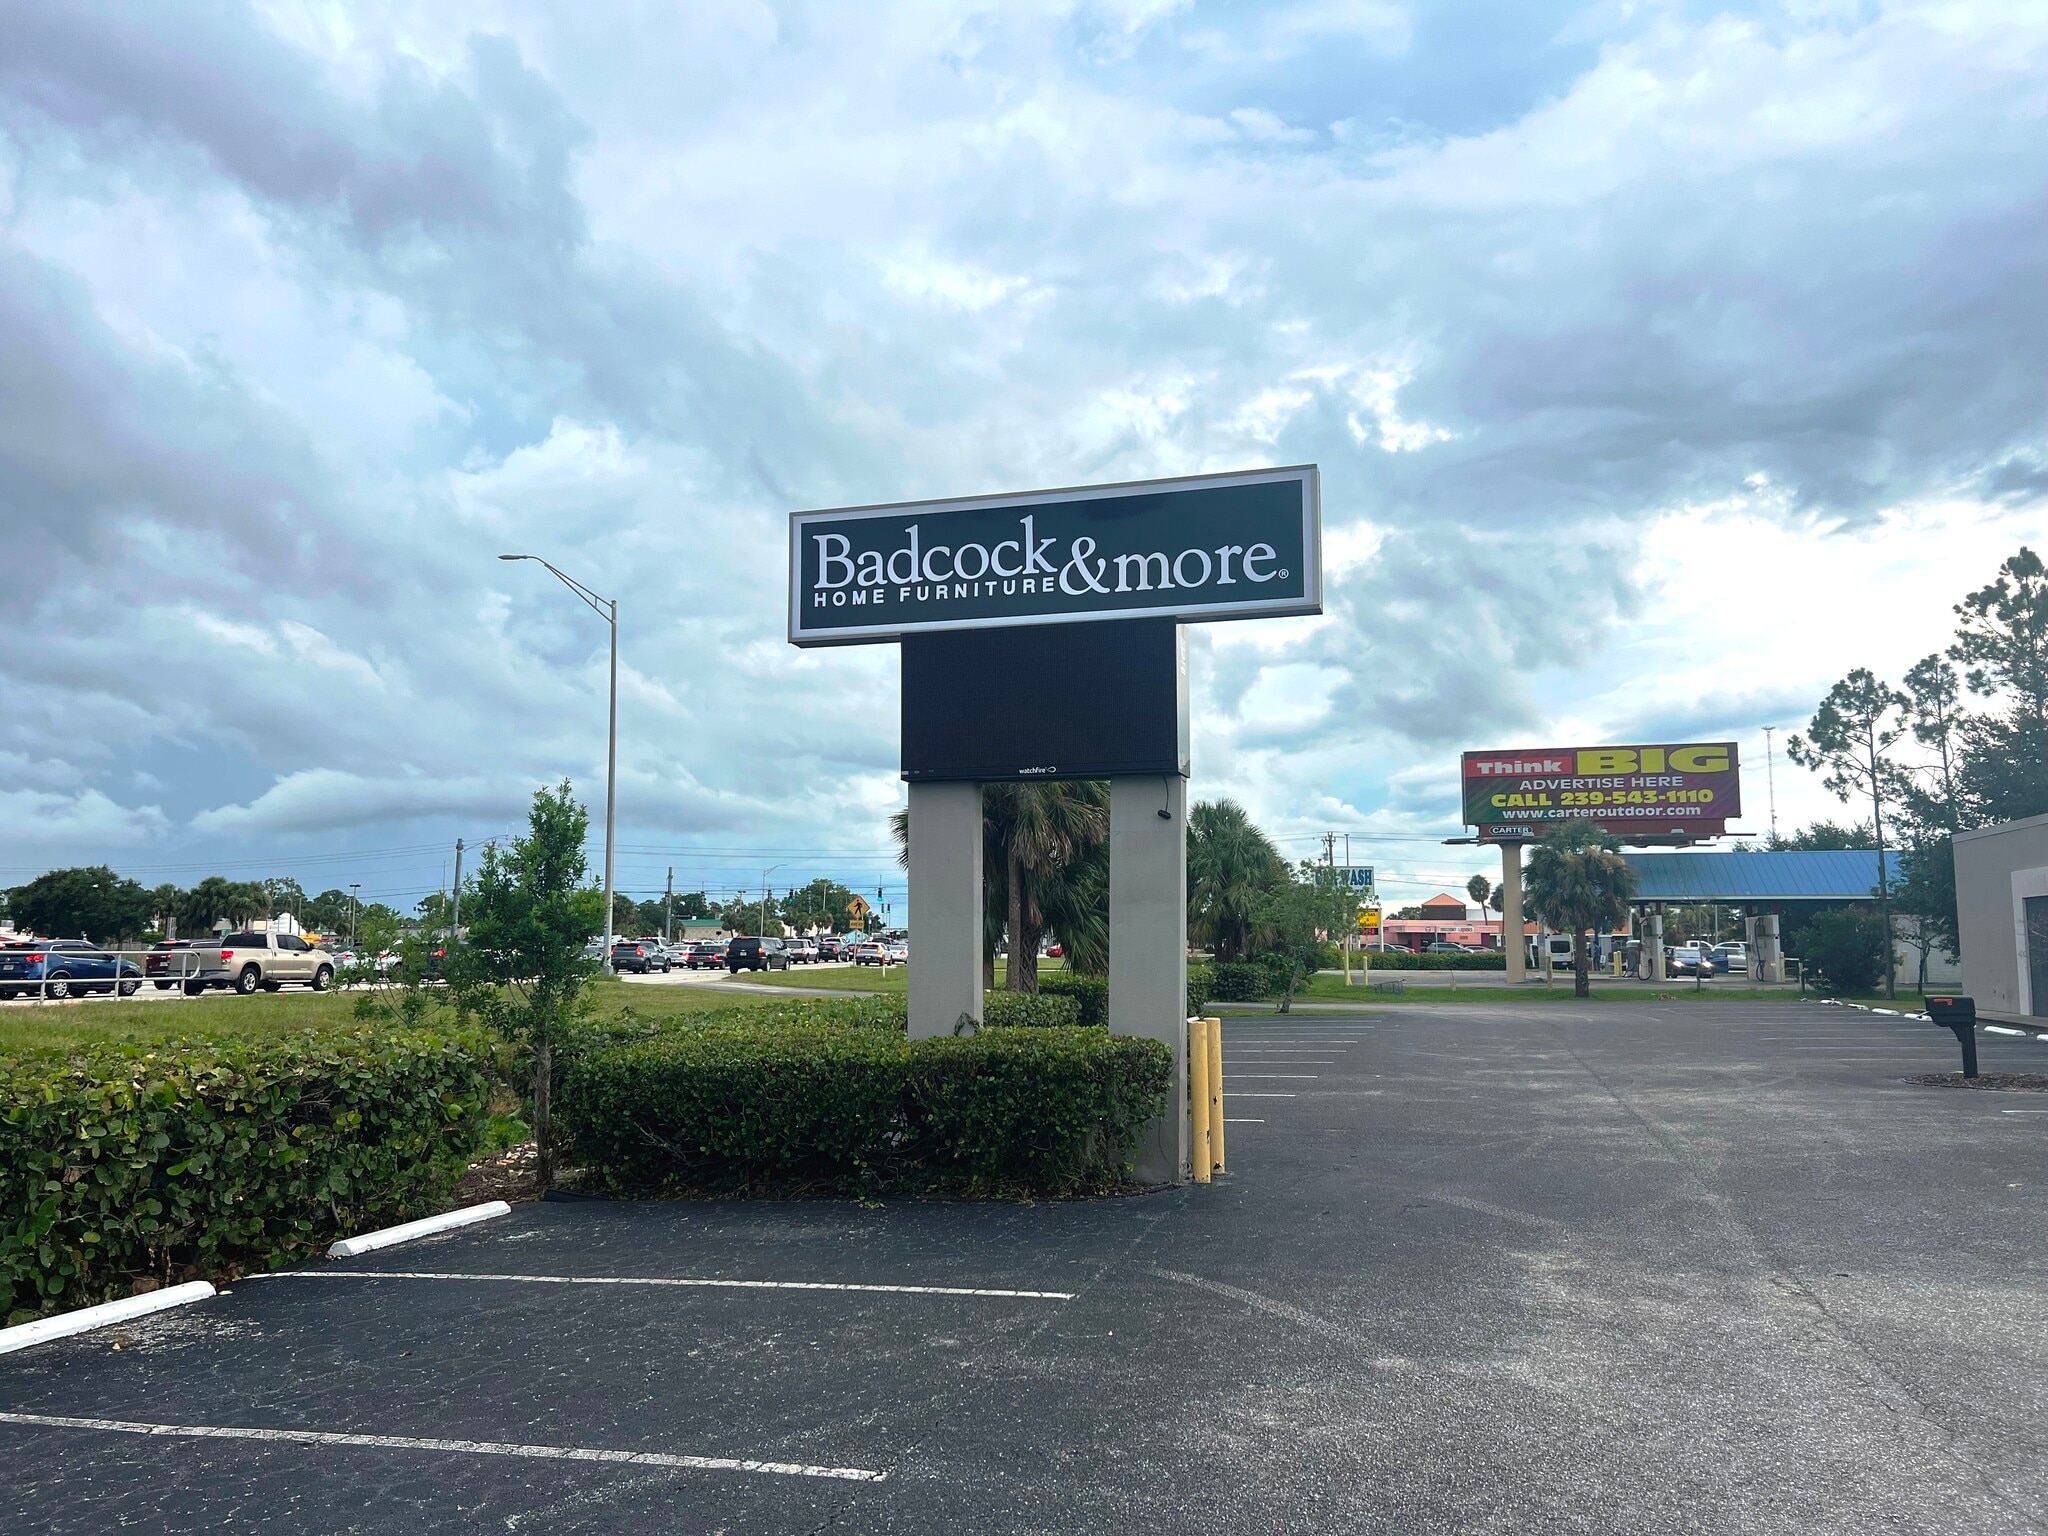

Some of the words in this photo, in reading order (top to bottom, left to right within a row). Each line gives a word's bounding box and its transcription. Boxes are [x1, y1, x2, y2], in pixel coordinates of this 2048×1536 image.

[814, 588, 885, 608] HOME
[899, 576, 1055, 602] FURNITURE
[1477, 760, 1562, 774] Think
[1576, 746, 1730, 775] BIG
[1519, 778, 1625, 791] ADVERTISE
[1631, 776, 1684, 788] HERE
[1491, 793, 1552, 808] CALL
[1560, 788, 1714, 806] 239-543-1110
[1502, 806, 1701, 819] www.carteroutdoor.com
[1492, 827, 1529, 835] CARTER
